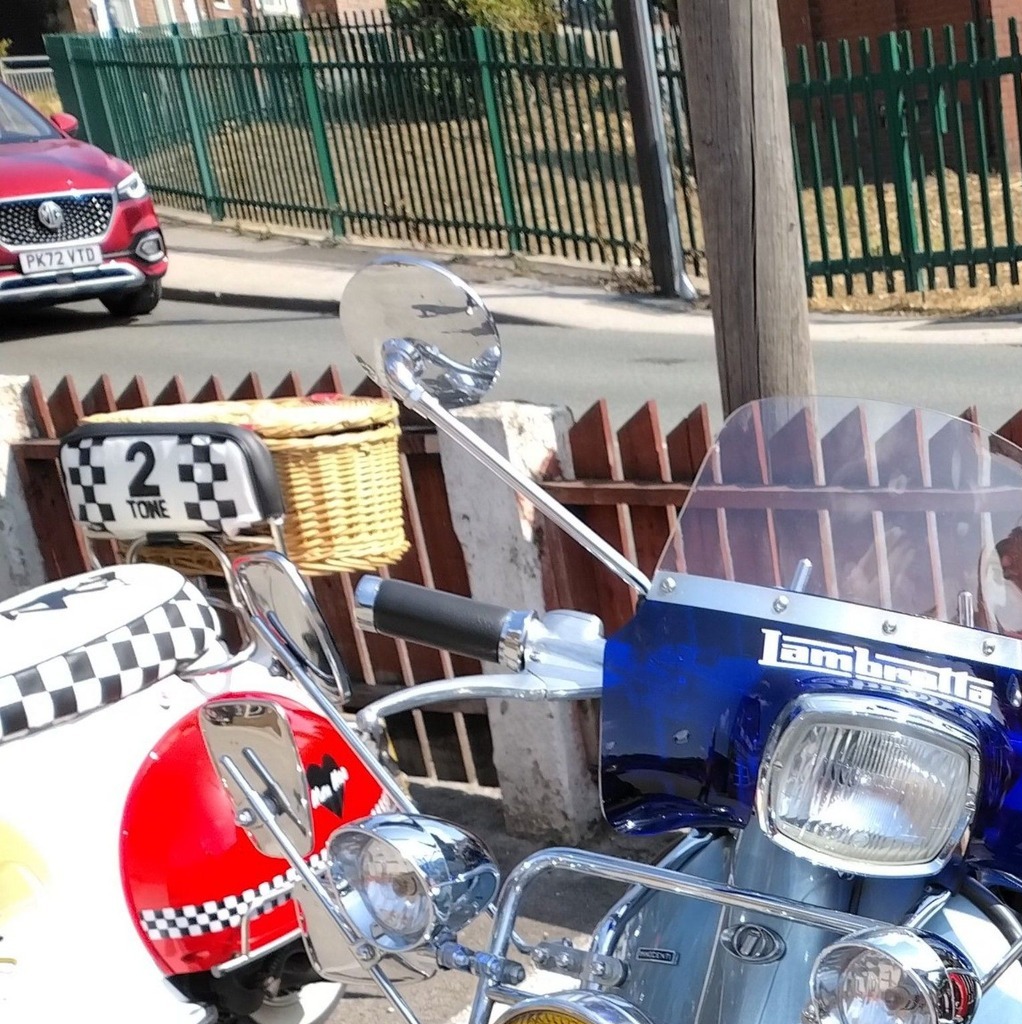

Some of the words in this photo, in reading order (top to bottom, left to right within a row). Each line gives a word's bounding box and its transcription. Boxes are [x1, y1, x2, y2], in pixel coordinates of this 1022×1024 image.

[27, 253, 64, 269] PK72
[67, 248, 95, 264] VTD
[125, 441, 161, 497] 2
[127, 500, 170, 519] TONE
